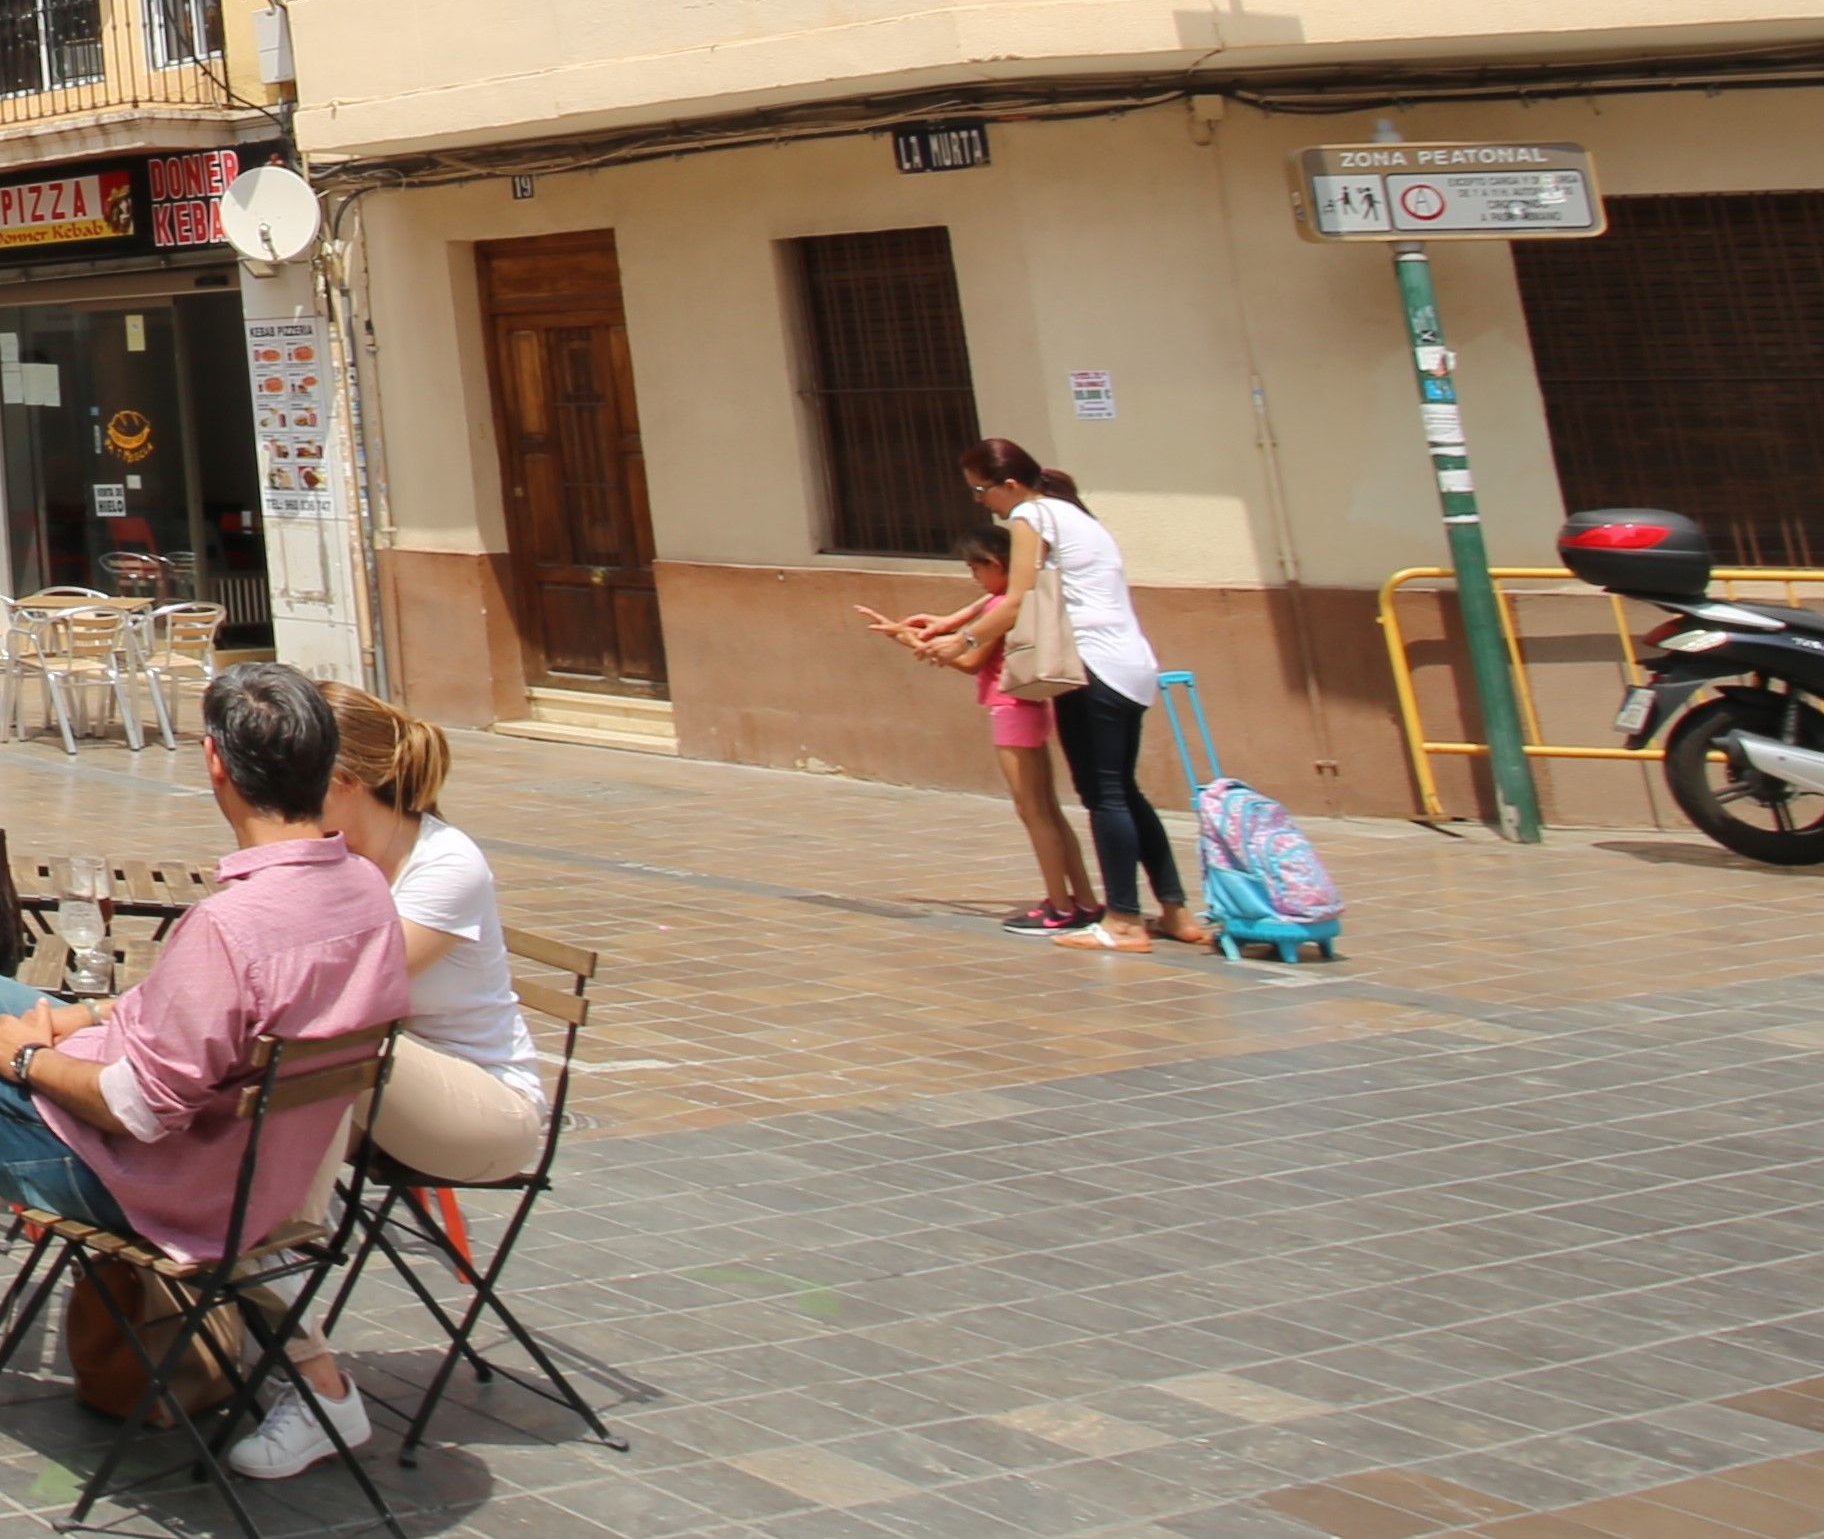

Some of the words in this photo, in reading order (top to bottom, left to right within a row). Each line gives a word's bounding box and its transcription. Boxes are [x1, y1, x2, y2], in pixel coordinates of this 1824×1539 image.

[898, 136, 924, 170] LA
[928, 129, 984, 167] MURTA
[1340, 152, 1408, 167] ZONA
[1418, 148, 1548, 165] PEATONAL
[149, 150, 239, 201] DONER
[515, 177, 531, 197] 19
[1, 185, 87, 226] PIZZA
[52, 220, 104, 239] Kebab
[152, 196, 228, 247] KEBA
[98, 500, 124, 512] HIELO
